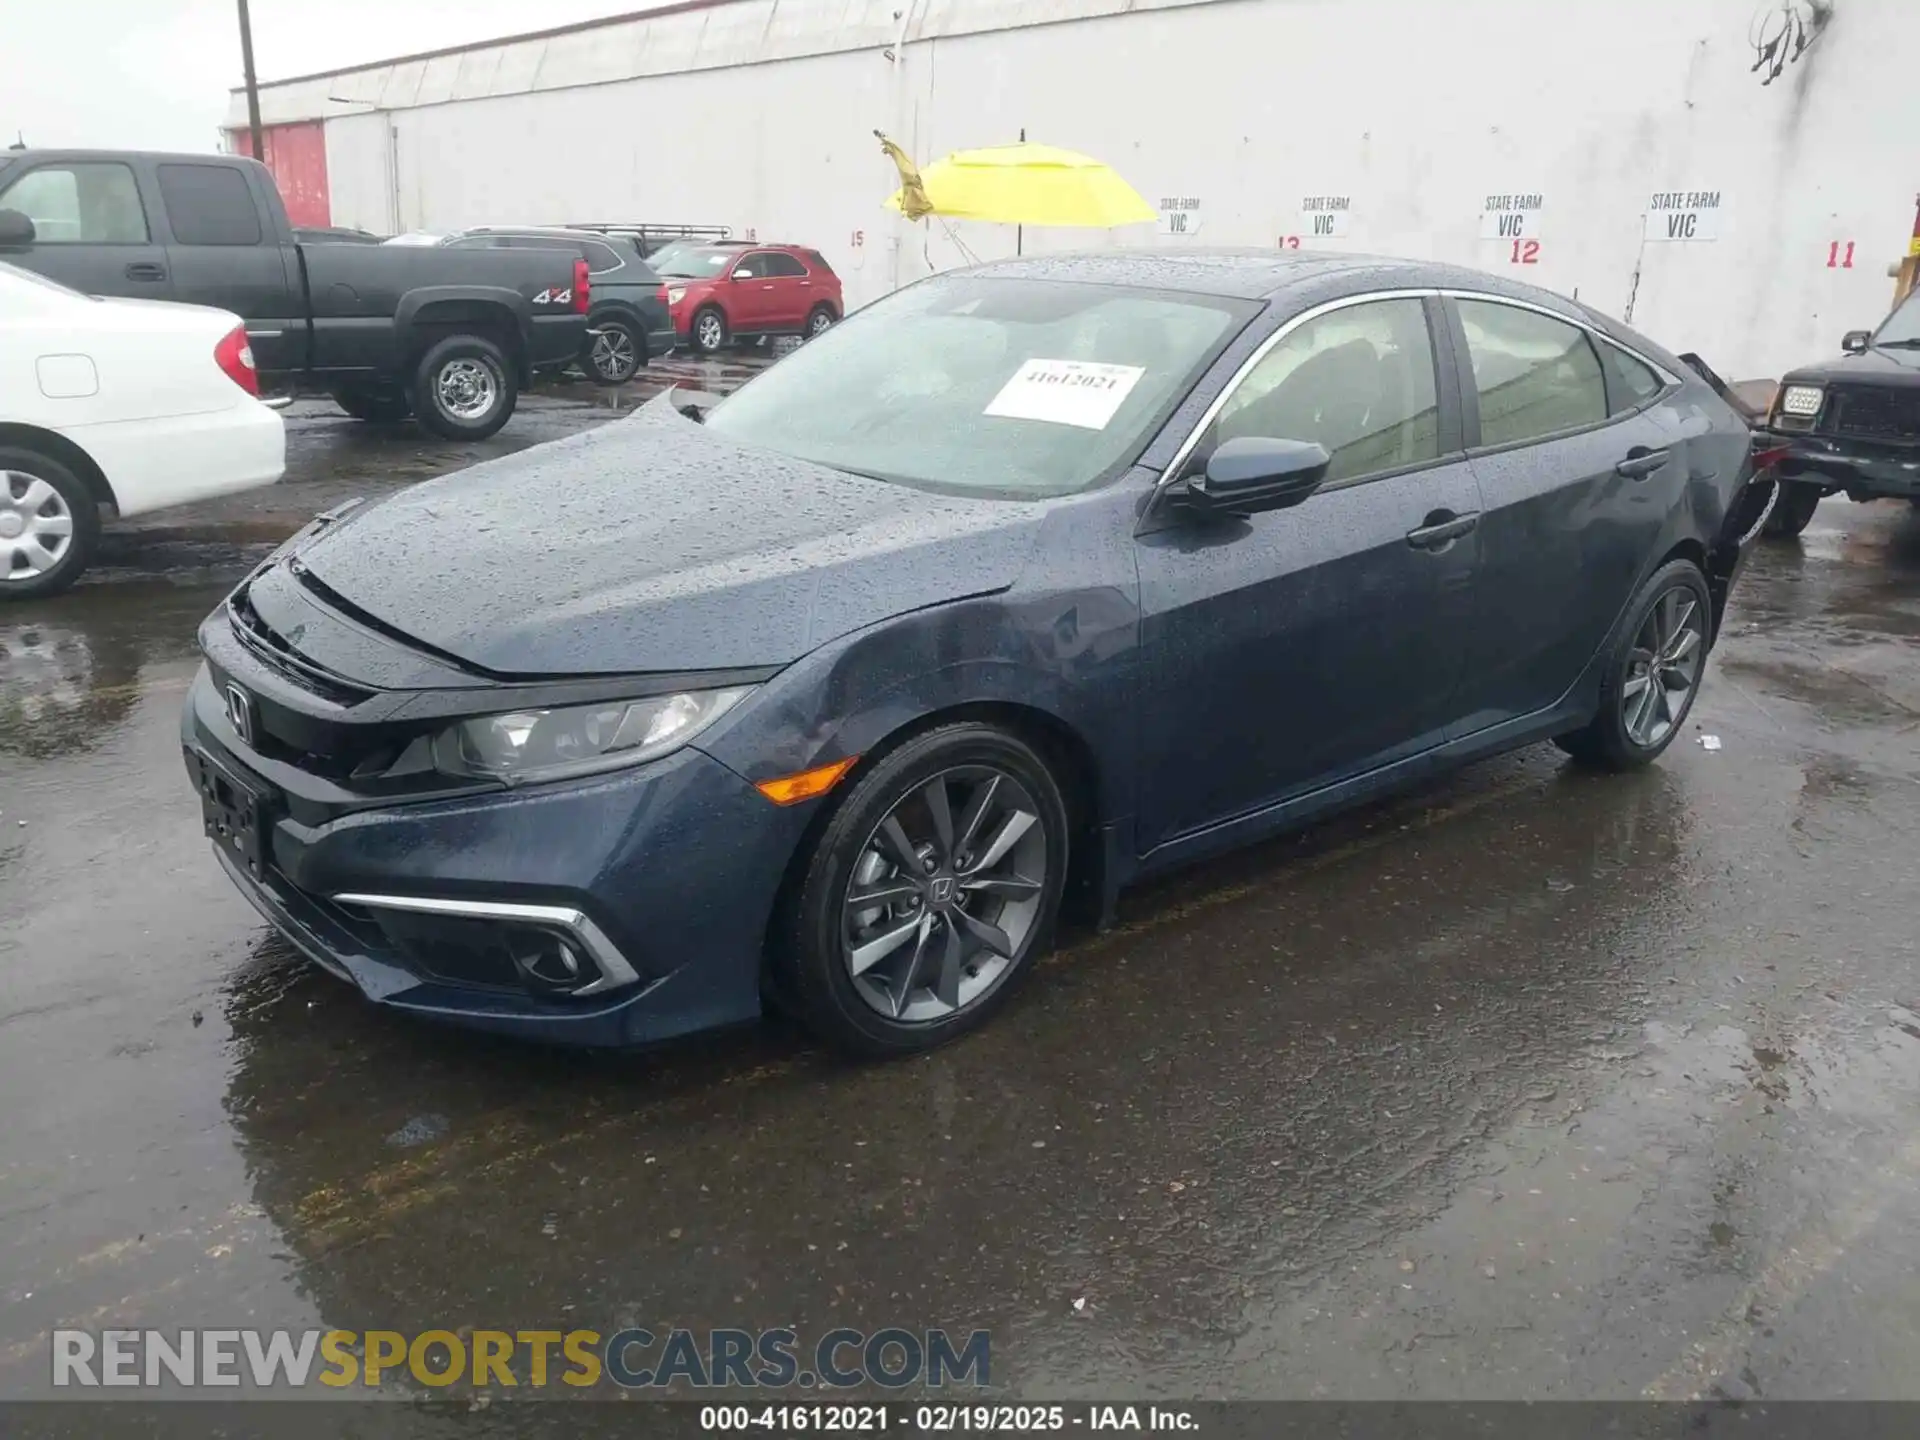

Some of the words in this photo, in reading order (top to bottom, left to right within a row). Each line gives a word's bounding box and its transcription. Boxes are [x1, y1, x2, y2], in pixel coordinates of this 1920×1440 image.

[1160, 198, 1179, 210] STATE
[1181, 198, 1200, 210] FARM
[1302, 197, 1325, 211] STATE
[1327, 197, 1350, 211] FARM
[1485, 195, 1512, 211] STATE
[1514, 194, 1542, 210] FARM
[1652, 192, 1684, 209] STATE
[1686, 190, 1720, 209] FARM
[1170, 213, 1187, 232] VIC
[1314, 215, 1334, 234] VIC
[1499, 214, 1524, 237] VIC
[1668, 213, 1697, 238] VIC
[851, 230, 864, 247] 15
[1511, 239, 1540, 263] 12
[1826, 241, 1855, 268] 11
